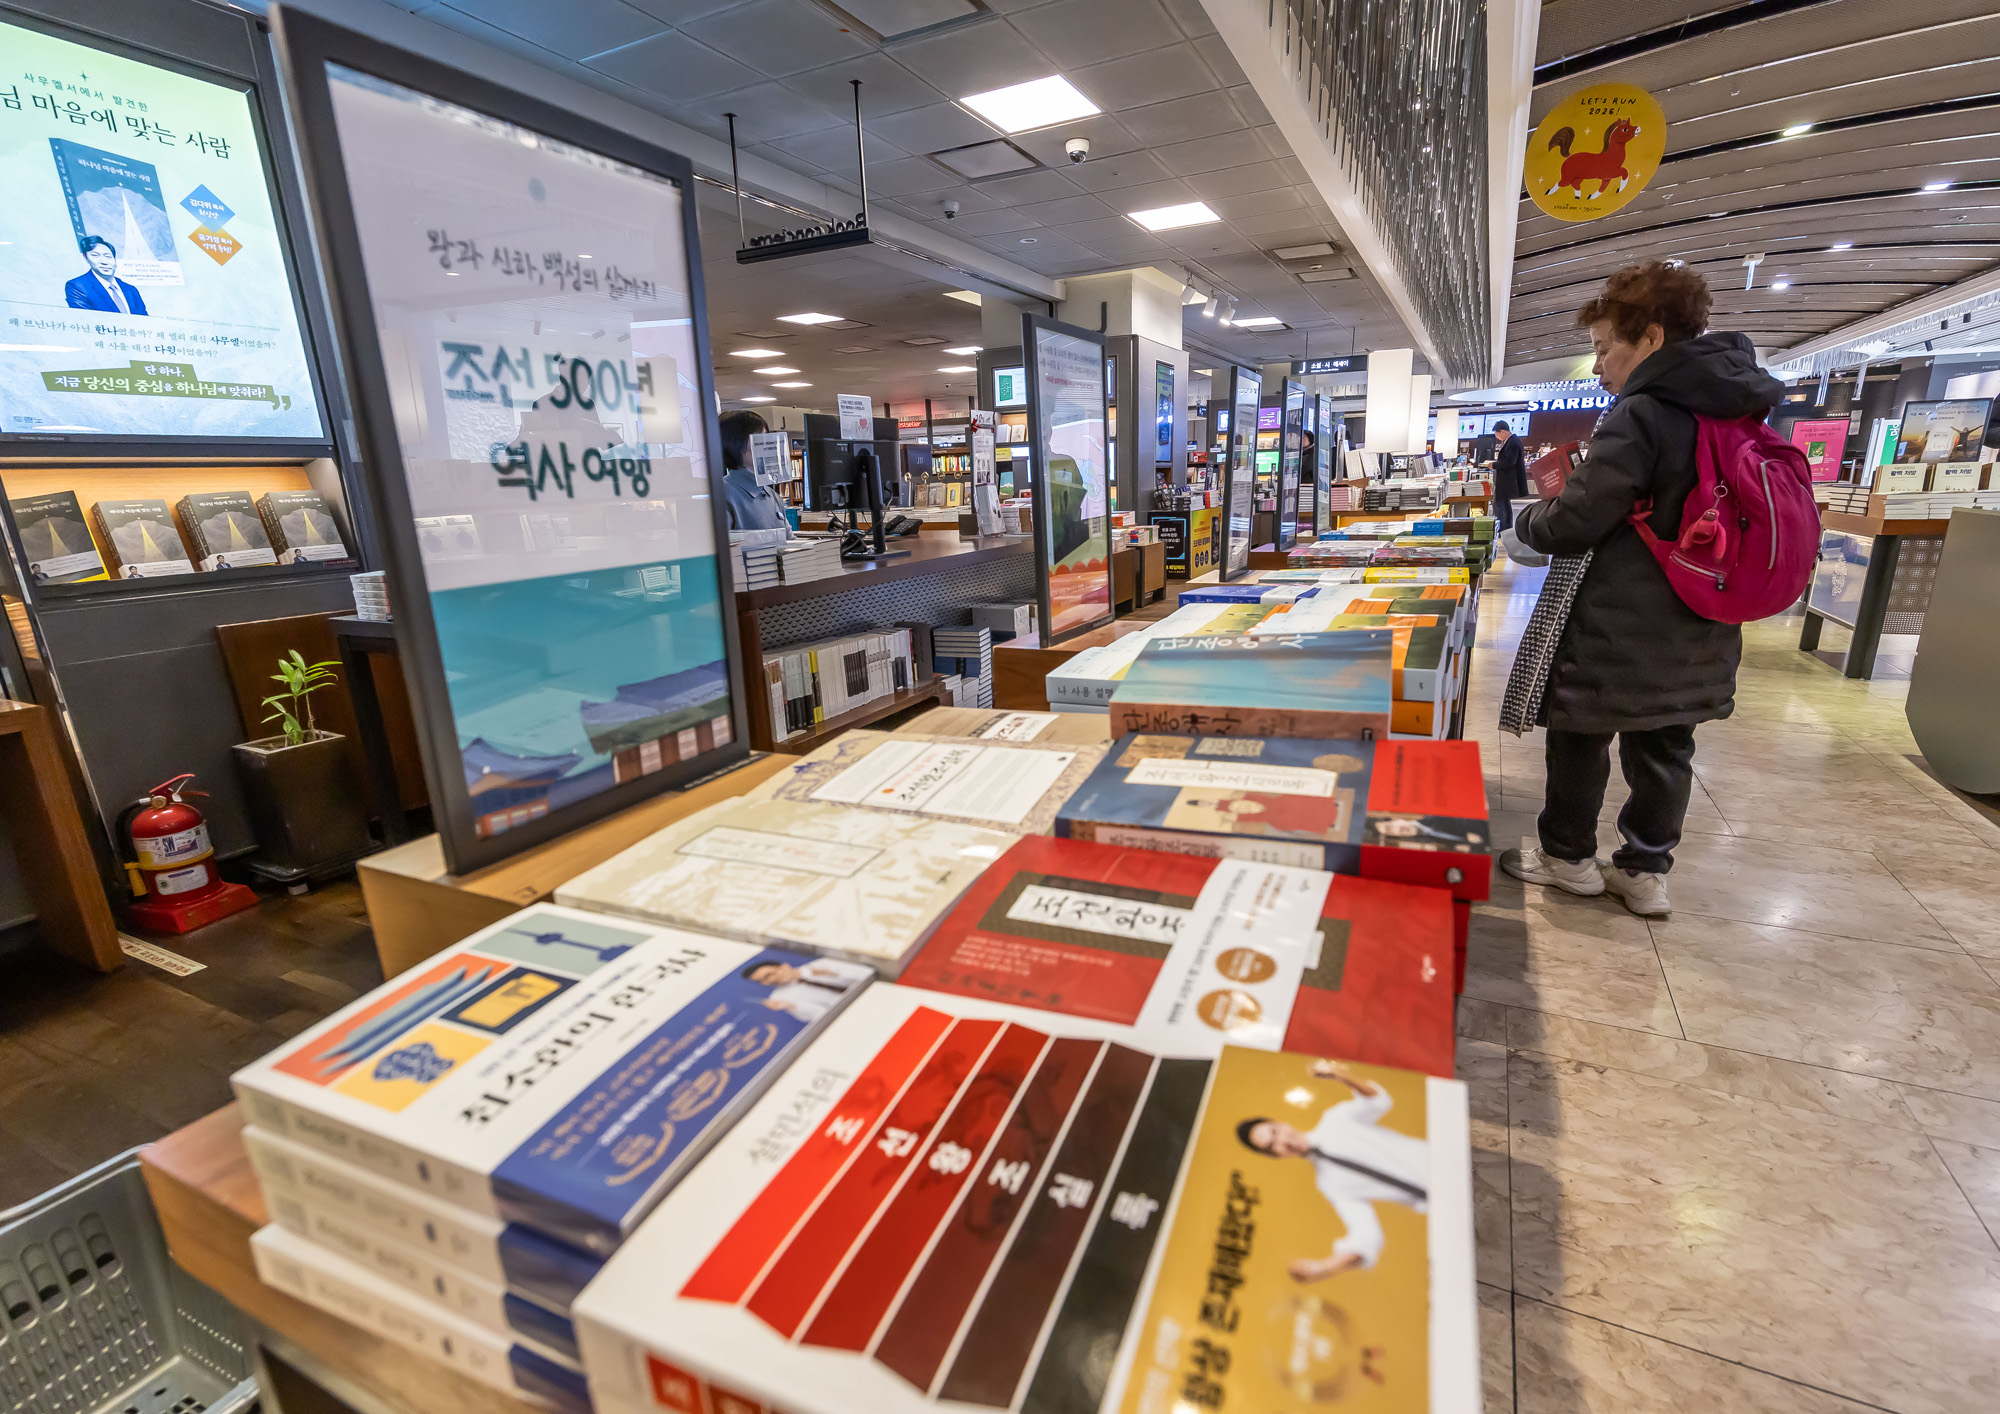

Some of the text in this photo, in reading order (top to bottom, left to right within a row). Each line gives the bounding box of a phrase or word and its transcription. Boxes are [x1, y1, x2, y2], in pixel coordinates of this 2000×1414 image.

[24, 72, 148, 113] 사무엘서에서 발견한
[1580, 97, 1608, 105] LET'S
[1588, 108, 1620, 116] 2026!
[31, 94, 119, 133] 마음에
[125, 115, 176, 147] 맞는
[185, 131, 231, 160] 사람
[426, 228, 484, 270] 왕과
[9, 317, 19, 327] 왜
[24, 319, 66, 331] 브닌나가
[70, 323, 91, 334] 아닌
[95, 324, 153, 338] 한나였을까?
[156, 331, 165, 340] 왜
[189, 334, 207, 344] 대신
[209, 335, 277, 350] 사무엘이었을까?
[94, 340, 219, 358] 왜 사울 대신 다윗이었을까?
[144, 365, 156, 376] 단
[440, 340, 658, 416] 조선 500년
[1299, 362, 1307, 374] J
[55, 375, 267, 399] 지금 당신의 중심을 하나님께 맞춰라!
[1528, 396, 1616, 411] STARBU
[780, 416, 786, 430] J
[490, 441, 652, 501] 역사 여행
[1058, 686, 1114, 699] 나 사용 설명
[748, 1068, 851, 1166] 설민석의
